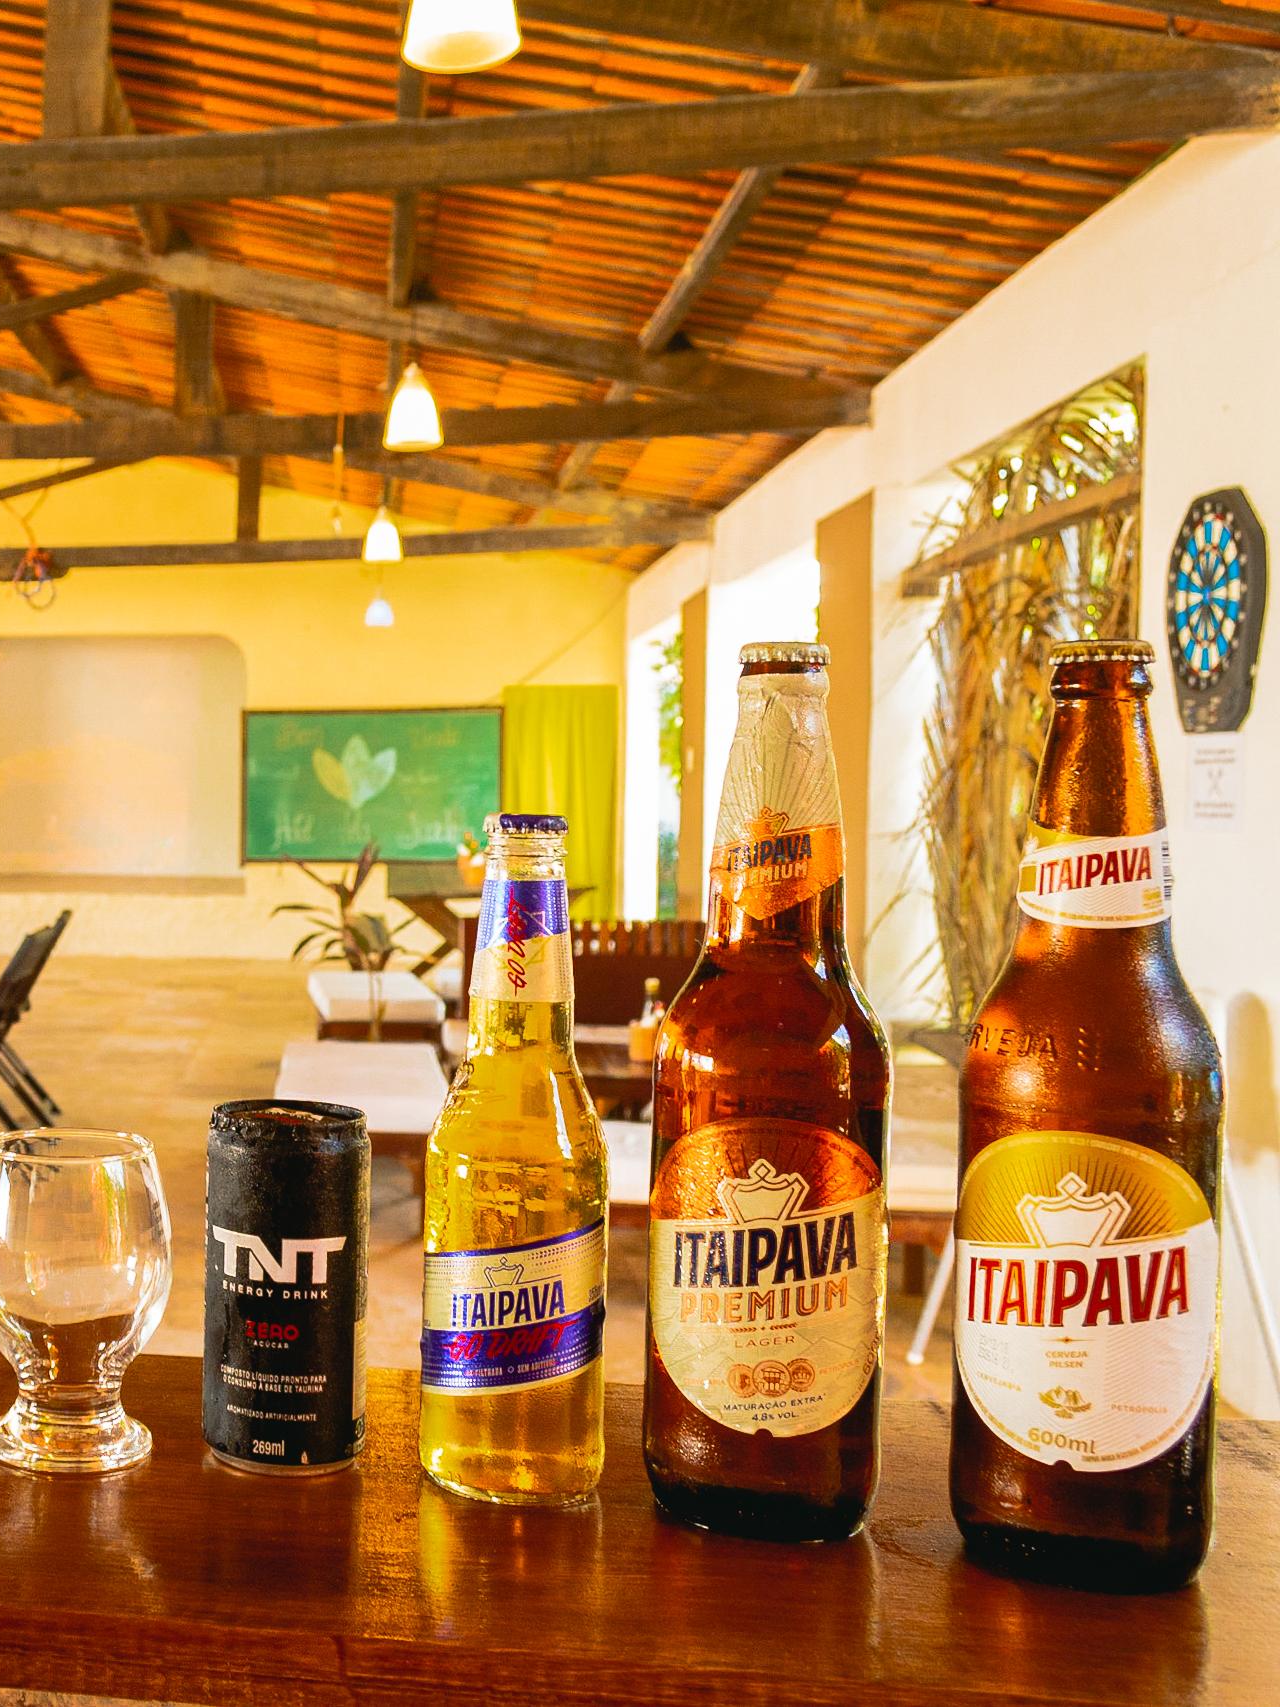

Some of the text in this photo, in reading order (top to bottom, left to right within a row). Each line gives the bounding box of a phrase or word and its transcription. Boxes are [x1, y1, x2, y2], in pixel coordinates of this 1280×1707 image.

[728, 834, 812, 873] ITAIPAVA
[740, 861, 809, 884] EMIUM
[1038, 846, 1152, 896] ITAIPAVA
[212, 1224, 347, 1284] TNT
[673, 1211, 858, 1289] ITAIPAVA
[222, 1279, 328, 1300] ENERGY DRINK
[967, 1246, 1190, 1328] ITAIPAVA
[451, 1279, 566, 1328] ITAIPAVA
[679, 1276, 849, 1324] PREMIUM
[245, 1320, 300, 1341] ZERO
[441, 1318, 581, 1361] GO DRAFT
[734, 1335, 796, 1348] LAGER
[1045, 1350, 1088, 1359] CERVEJA
[1048, 1360, 1084, 1369] PILSEN
[220, 1363, 327, 1385] COMPOSTO LÍQUIDO PRONTO PARA
[227, 1375, 257, 1390] CONSUMO
[264, 1384, 282, 1393] BASE
[284, 1385, 293, 1394] DE
[294, 1384, 324, 1394] TAURINA
[226, 1403, 318, 1422] AROMATIZADO ARTIFICIALMENTE
[723, 1400, 787, 1412] MATURAÇÃO
[777, 1411, 800, 1420] VOL.
[252, 1439, 286, 1457] 269ml
[1027, 1426, 1096, 1455] 600ml
